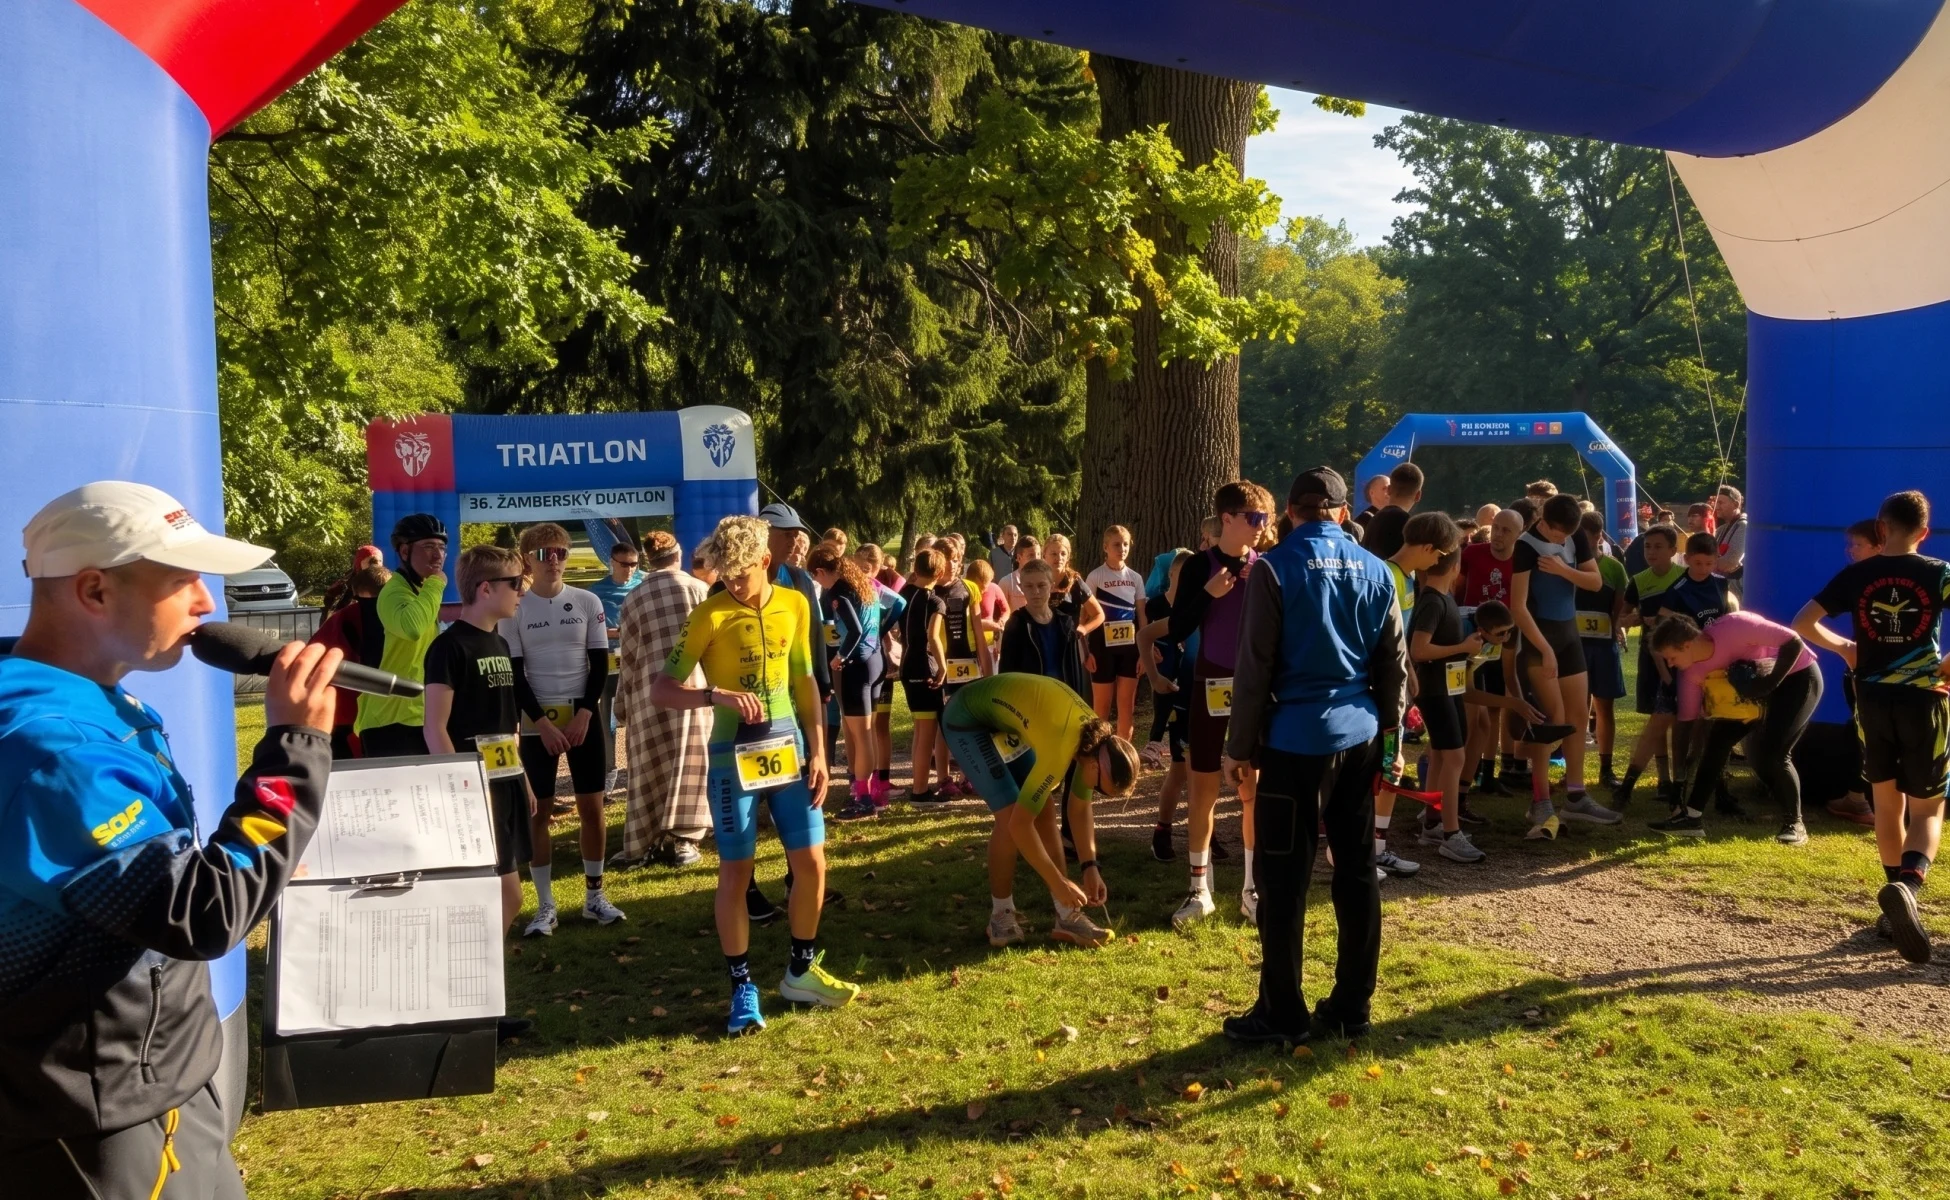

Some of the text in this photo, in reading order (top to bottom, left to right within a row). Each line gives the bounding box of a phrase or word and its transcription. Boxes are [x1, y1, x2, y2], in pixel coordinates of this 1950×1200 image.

[496, 439, 647, 467] TRIATLON
[469, 490, 665, 509] 36. ŽAMBERSKÝ DUATLON
[1112, 626, 1130, 640] 237
[756, 753, 782, 777] 36
[92, 799, 143, 846] SOP
